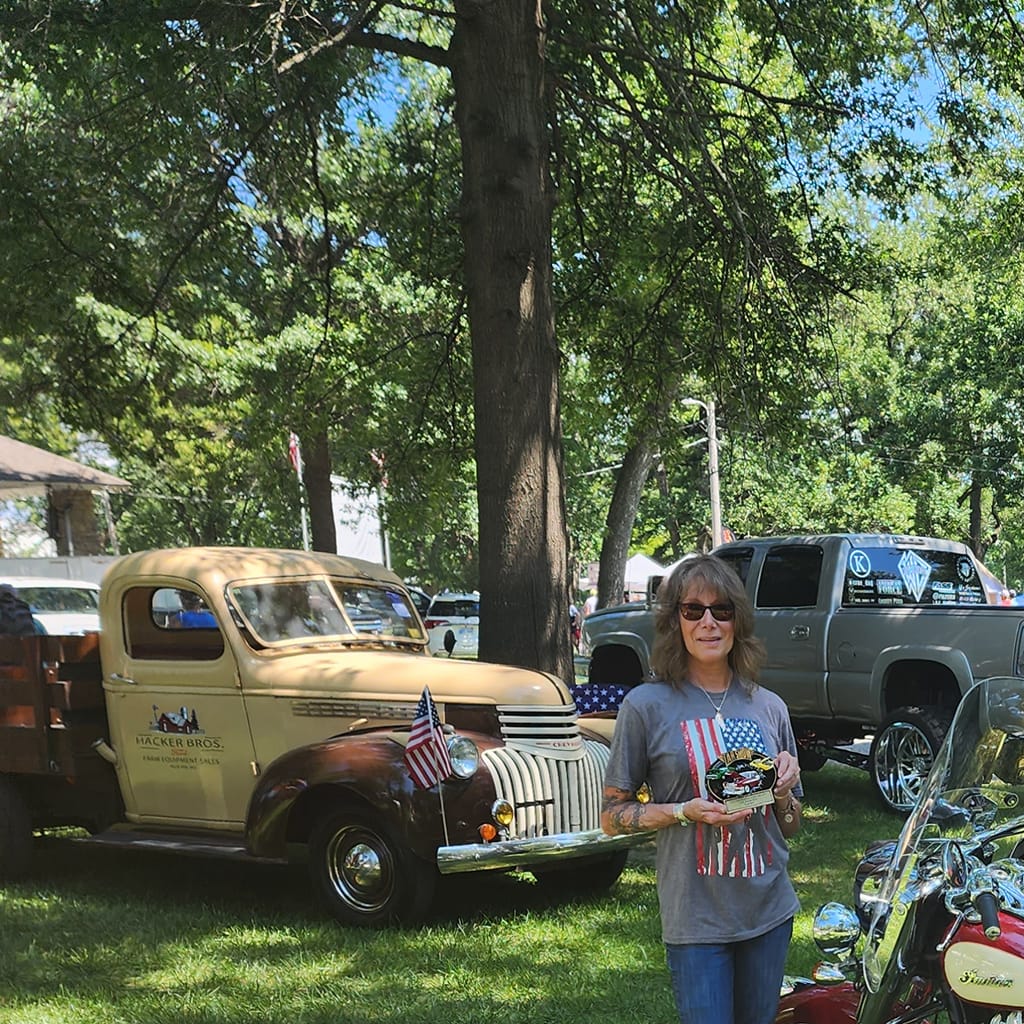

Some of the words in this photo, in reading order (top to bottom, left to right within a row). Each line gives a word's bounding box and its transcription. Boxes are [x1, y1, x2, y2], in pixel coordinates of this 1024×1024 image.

[853, 555, 867, 573] K
[135, 736, 183, 748] HACKER
[186, 739, 225, 749] BROS.
